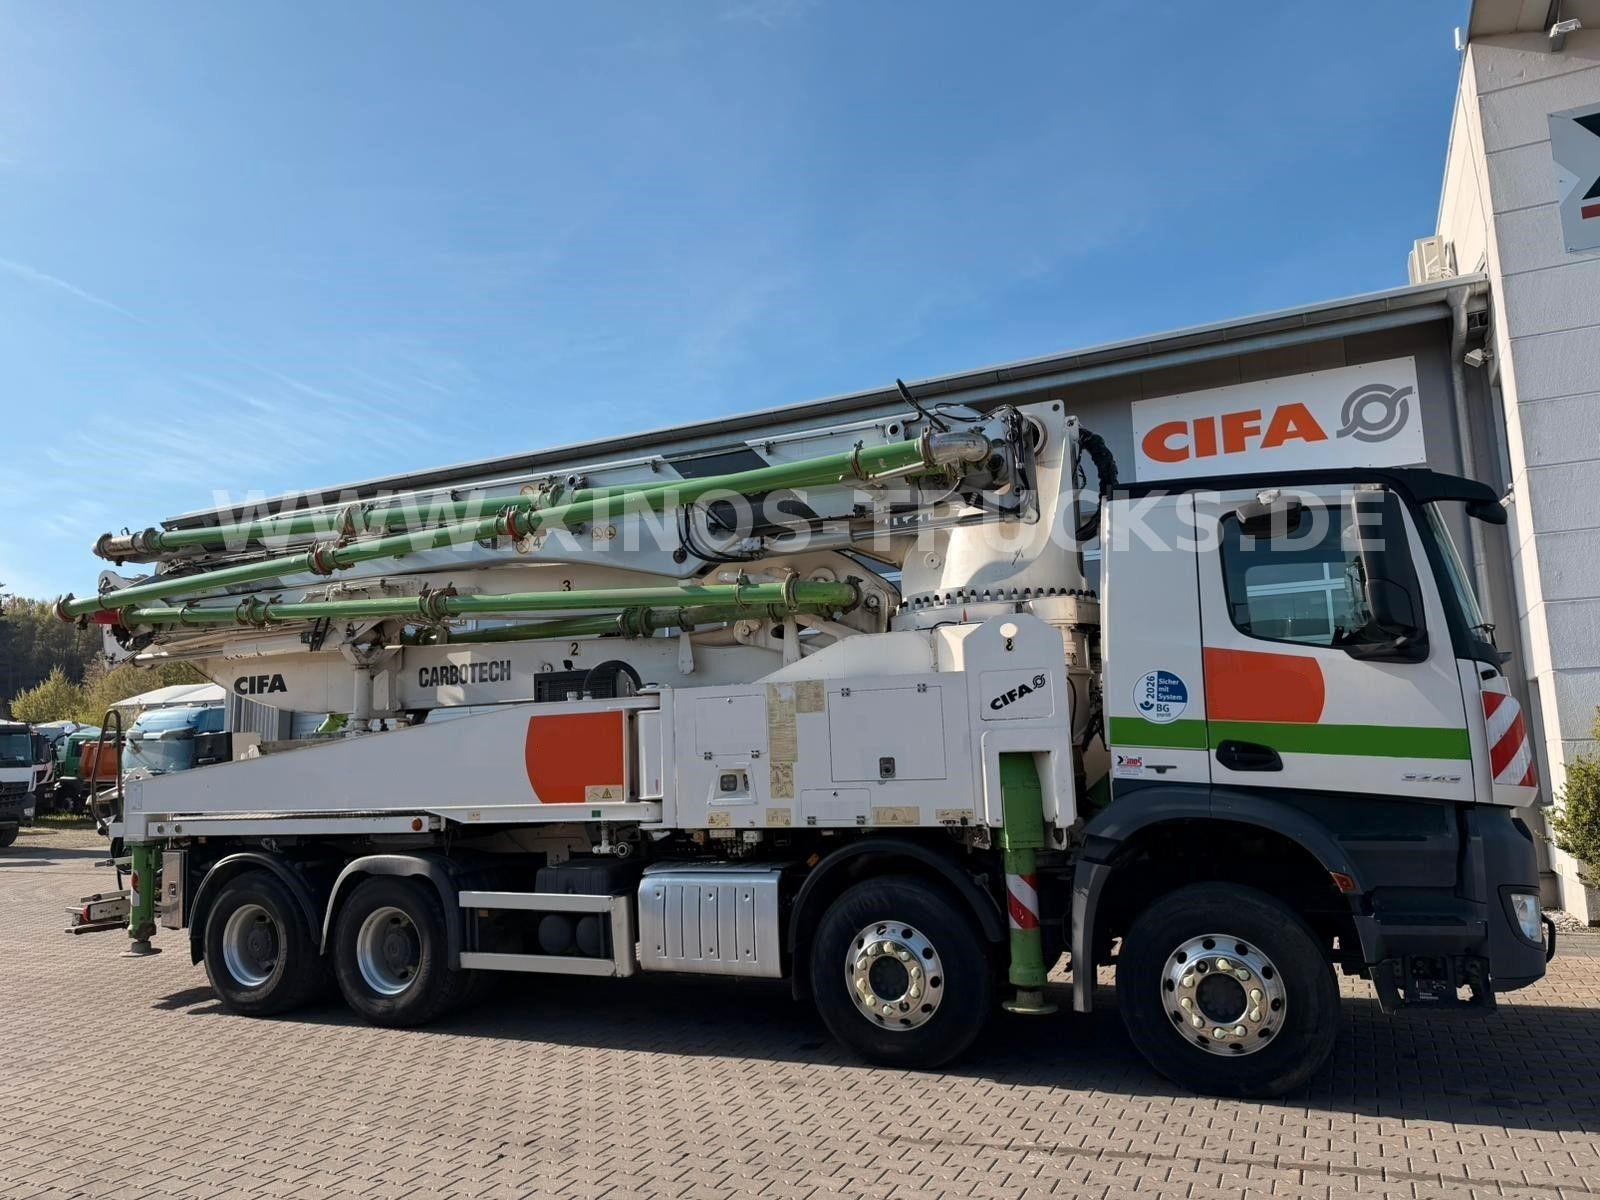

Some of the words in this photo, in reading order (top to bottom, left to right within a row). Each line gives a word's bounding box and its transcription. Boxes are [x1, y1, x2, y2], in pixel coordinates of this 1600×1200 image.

[1141, 402, 1329, 463] CIFA
[562, 579, 572, 592] 3
[570, 641, 579, 656] 2
[418, 660, 512, 688] CARBOTECH
[1158, 678, 1179, 686] Sicher
[233, 673, 288, 696] CIFA
[1146, 675, 1155, 699] 2026
[990, 683, 1034, 711] CIFA
[1158, 692, 1183, 701] System
[1156, 703, 1170, 712] BG
